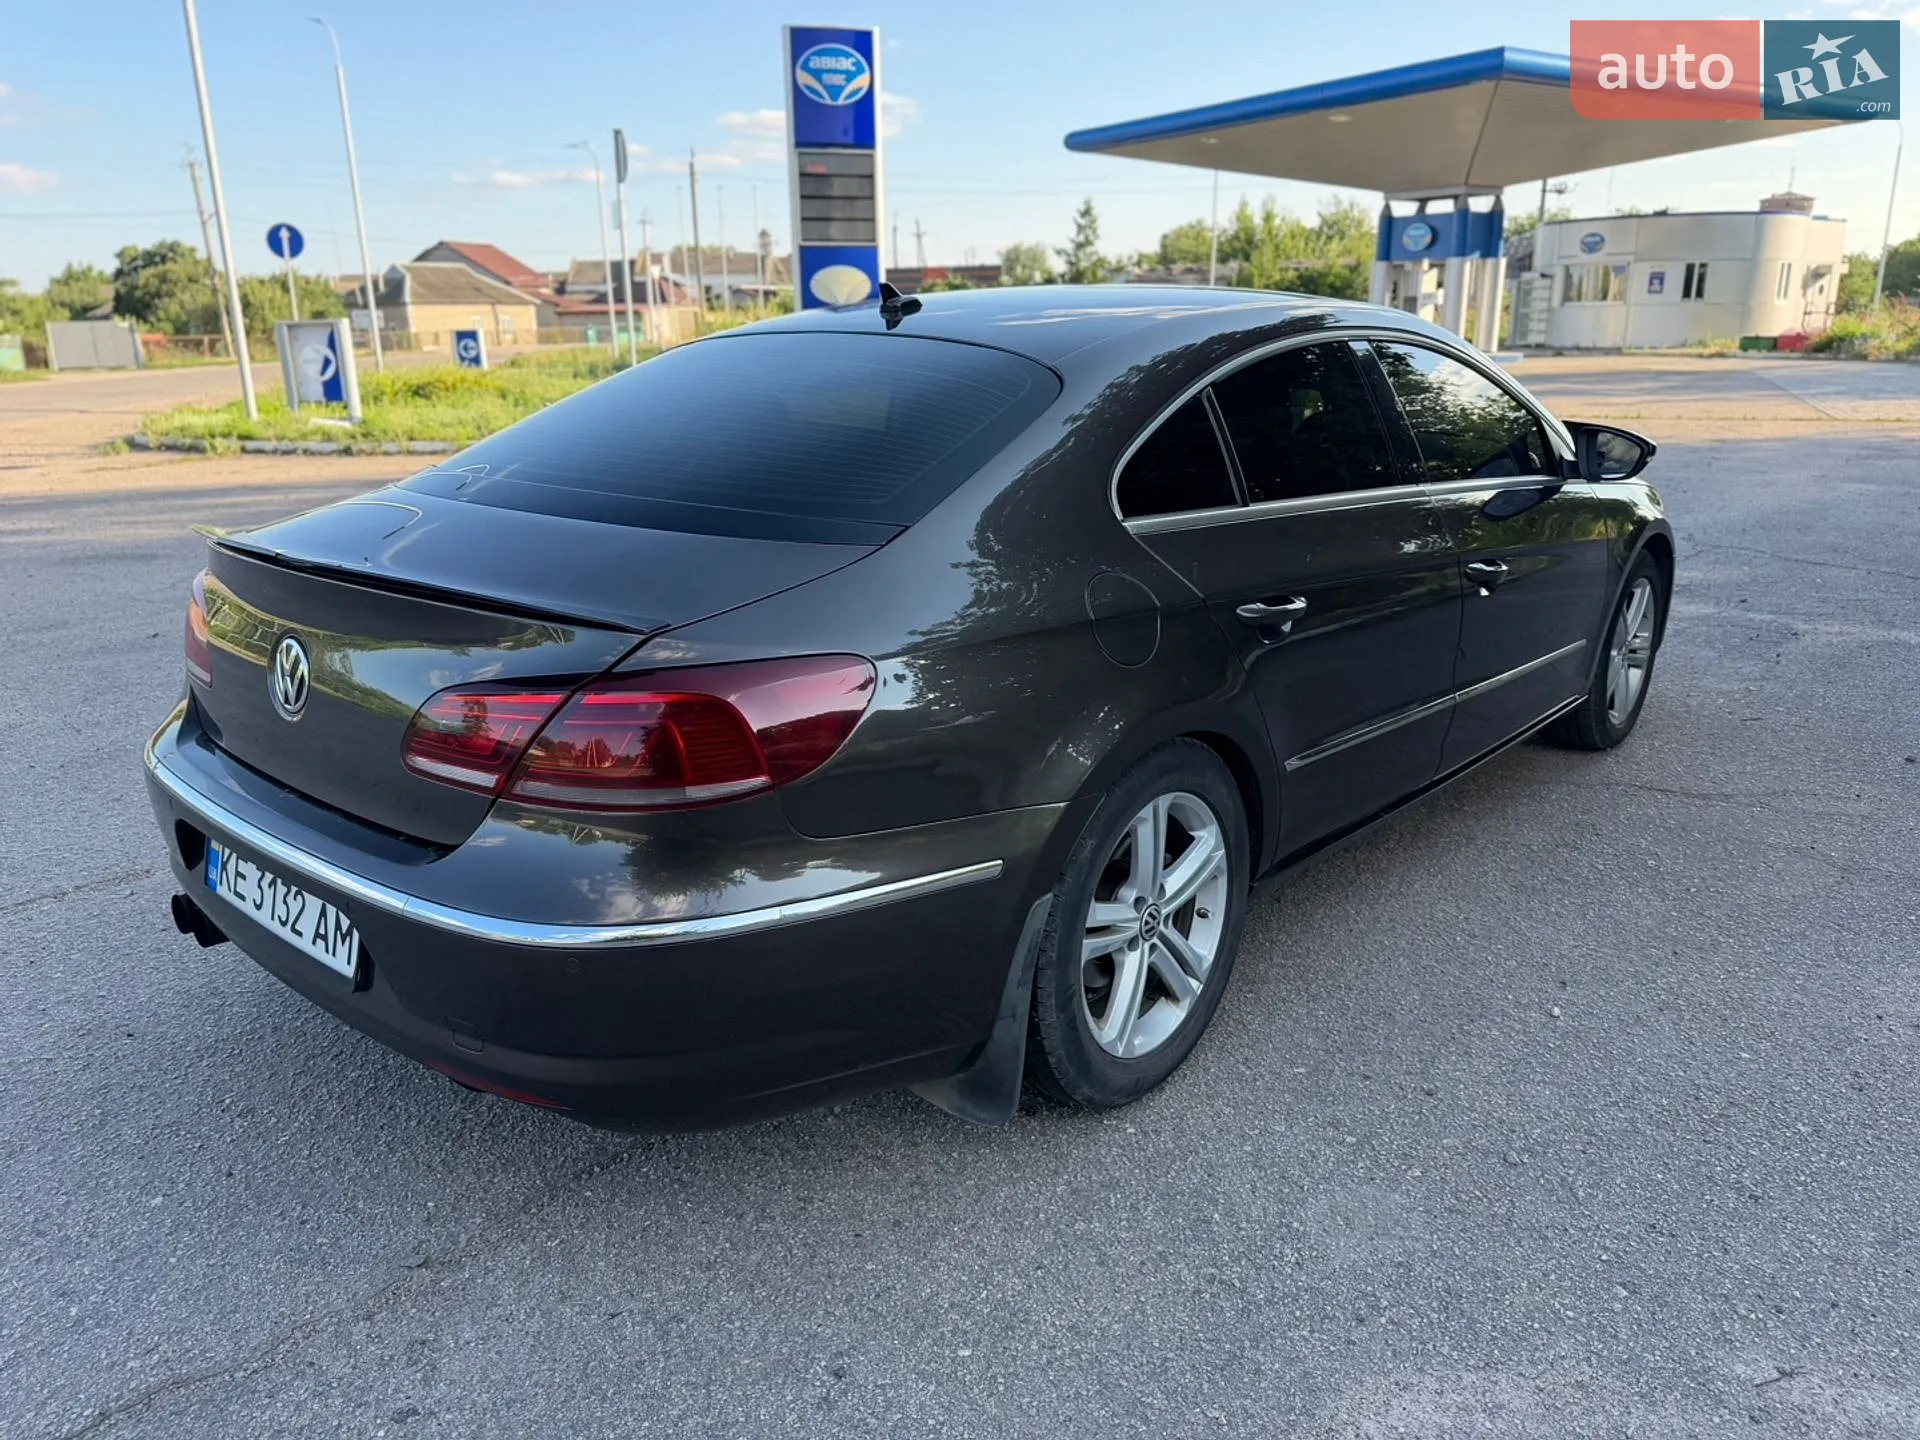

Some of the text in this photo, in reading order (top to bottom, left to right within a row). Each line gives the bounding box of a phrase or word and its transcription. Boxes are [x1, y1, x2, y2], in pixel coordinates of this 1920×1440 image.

[219, 845, 356, 966] KE 3132 AM
